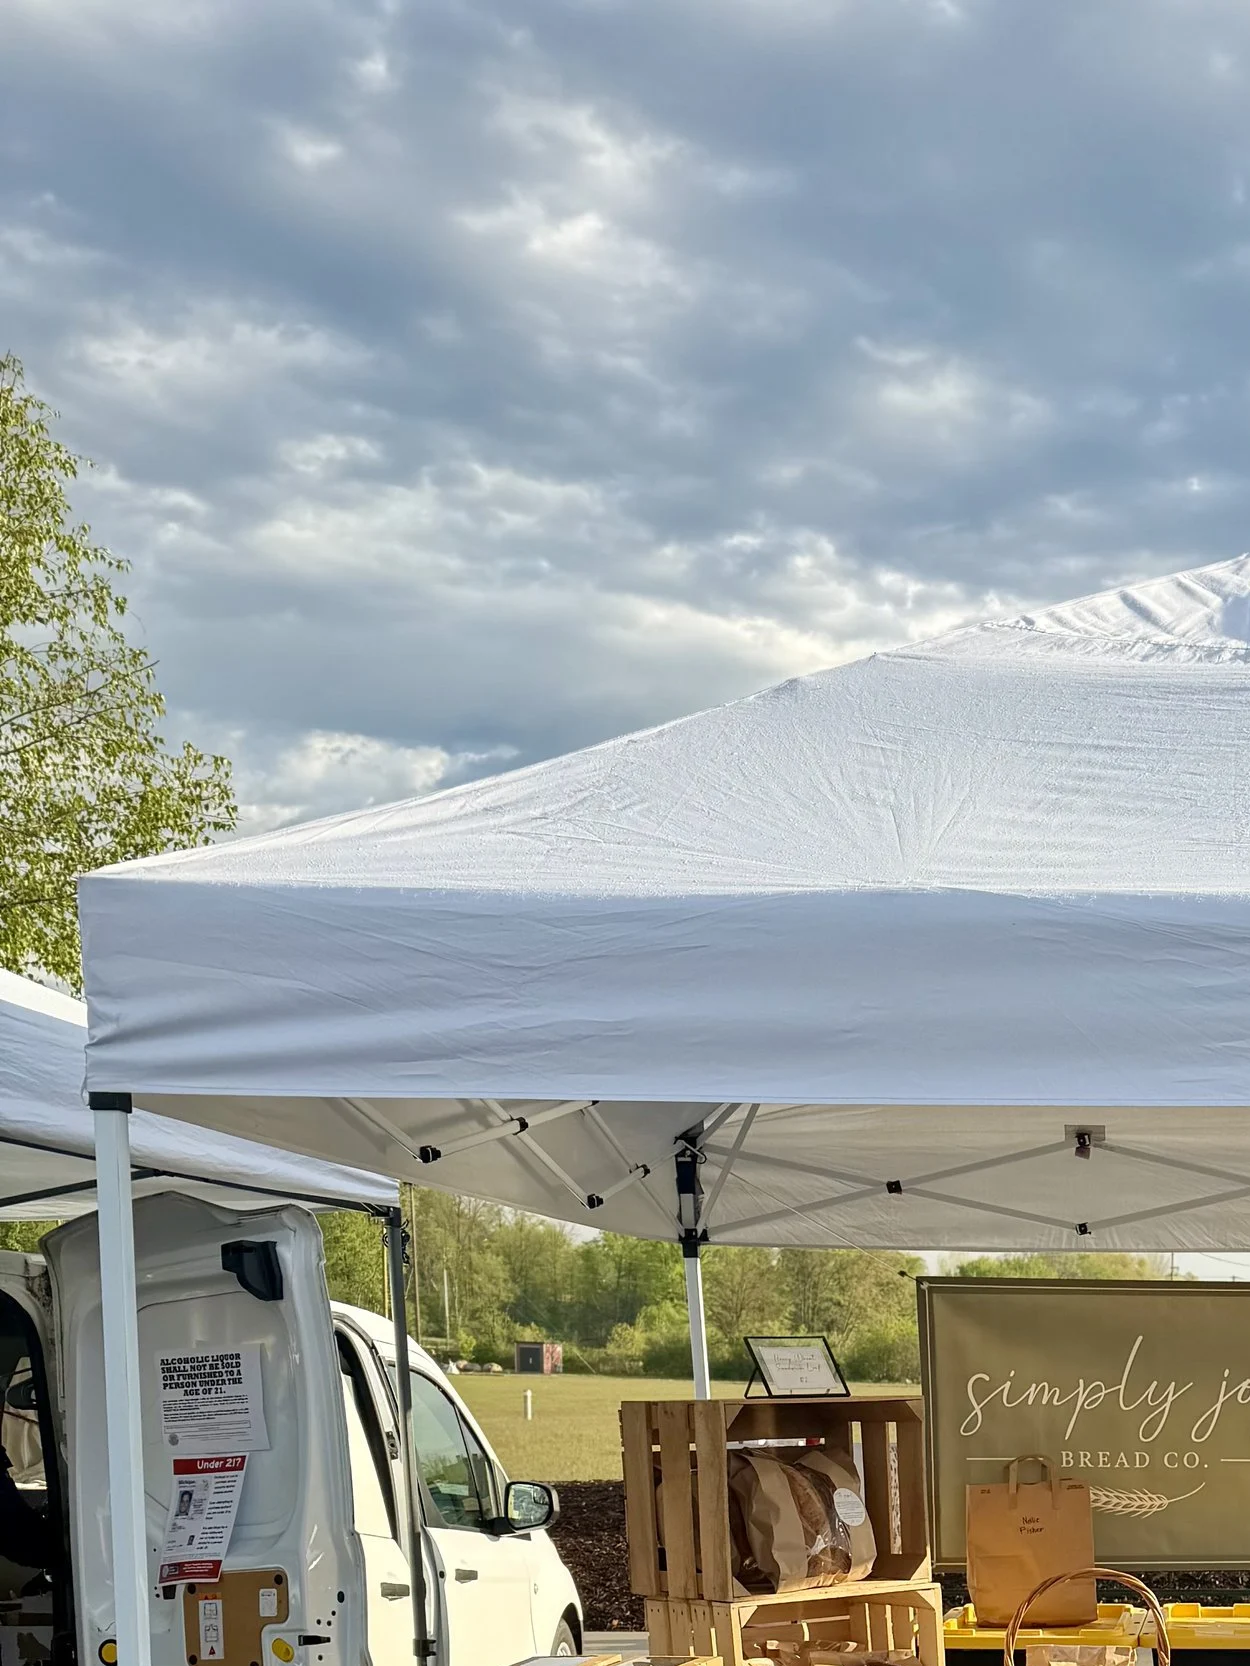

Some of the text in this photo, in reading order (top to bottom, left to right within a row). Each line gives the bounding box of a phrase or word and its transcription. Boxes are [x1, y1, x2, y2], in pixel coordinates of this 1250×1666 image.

[160, 1353, 241, 1366] ALCOHOLIC LIQUOR
[161, 1361, 241, 1374] SHALL NOT BE SOLD
[162, 1373, 175, 1382] OR
[176, 1370, 224, 1381] FURNISHED
[224, 1369, 235, 1377] TO
[162, 1377, 243, 1390] PERSON UNDER THE
[960, 1335, 1193, 1443] simply
[183, 1388, 200, 1396] AGE
[202, 1387, 213, 1396] OF
[197, 1460, 223, 1470] Under
[1060, 1451, 1209, 1469] BREAD CO.
